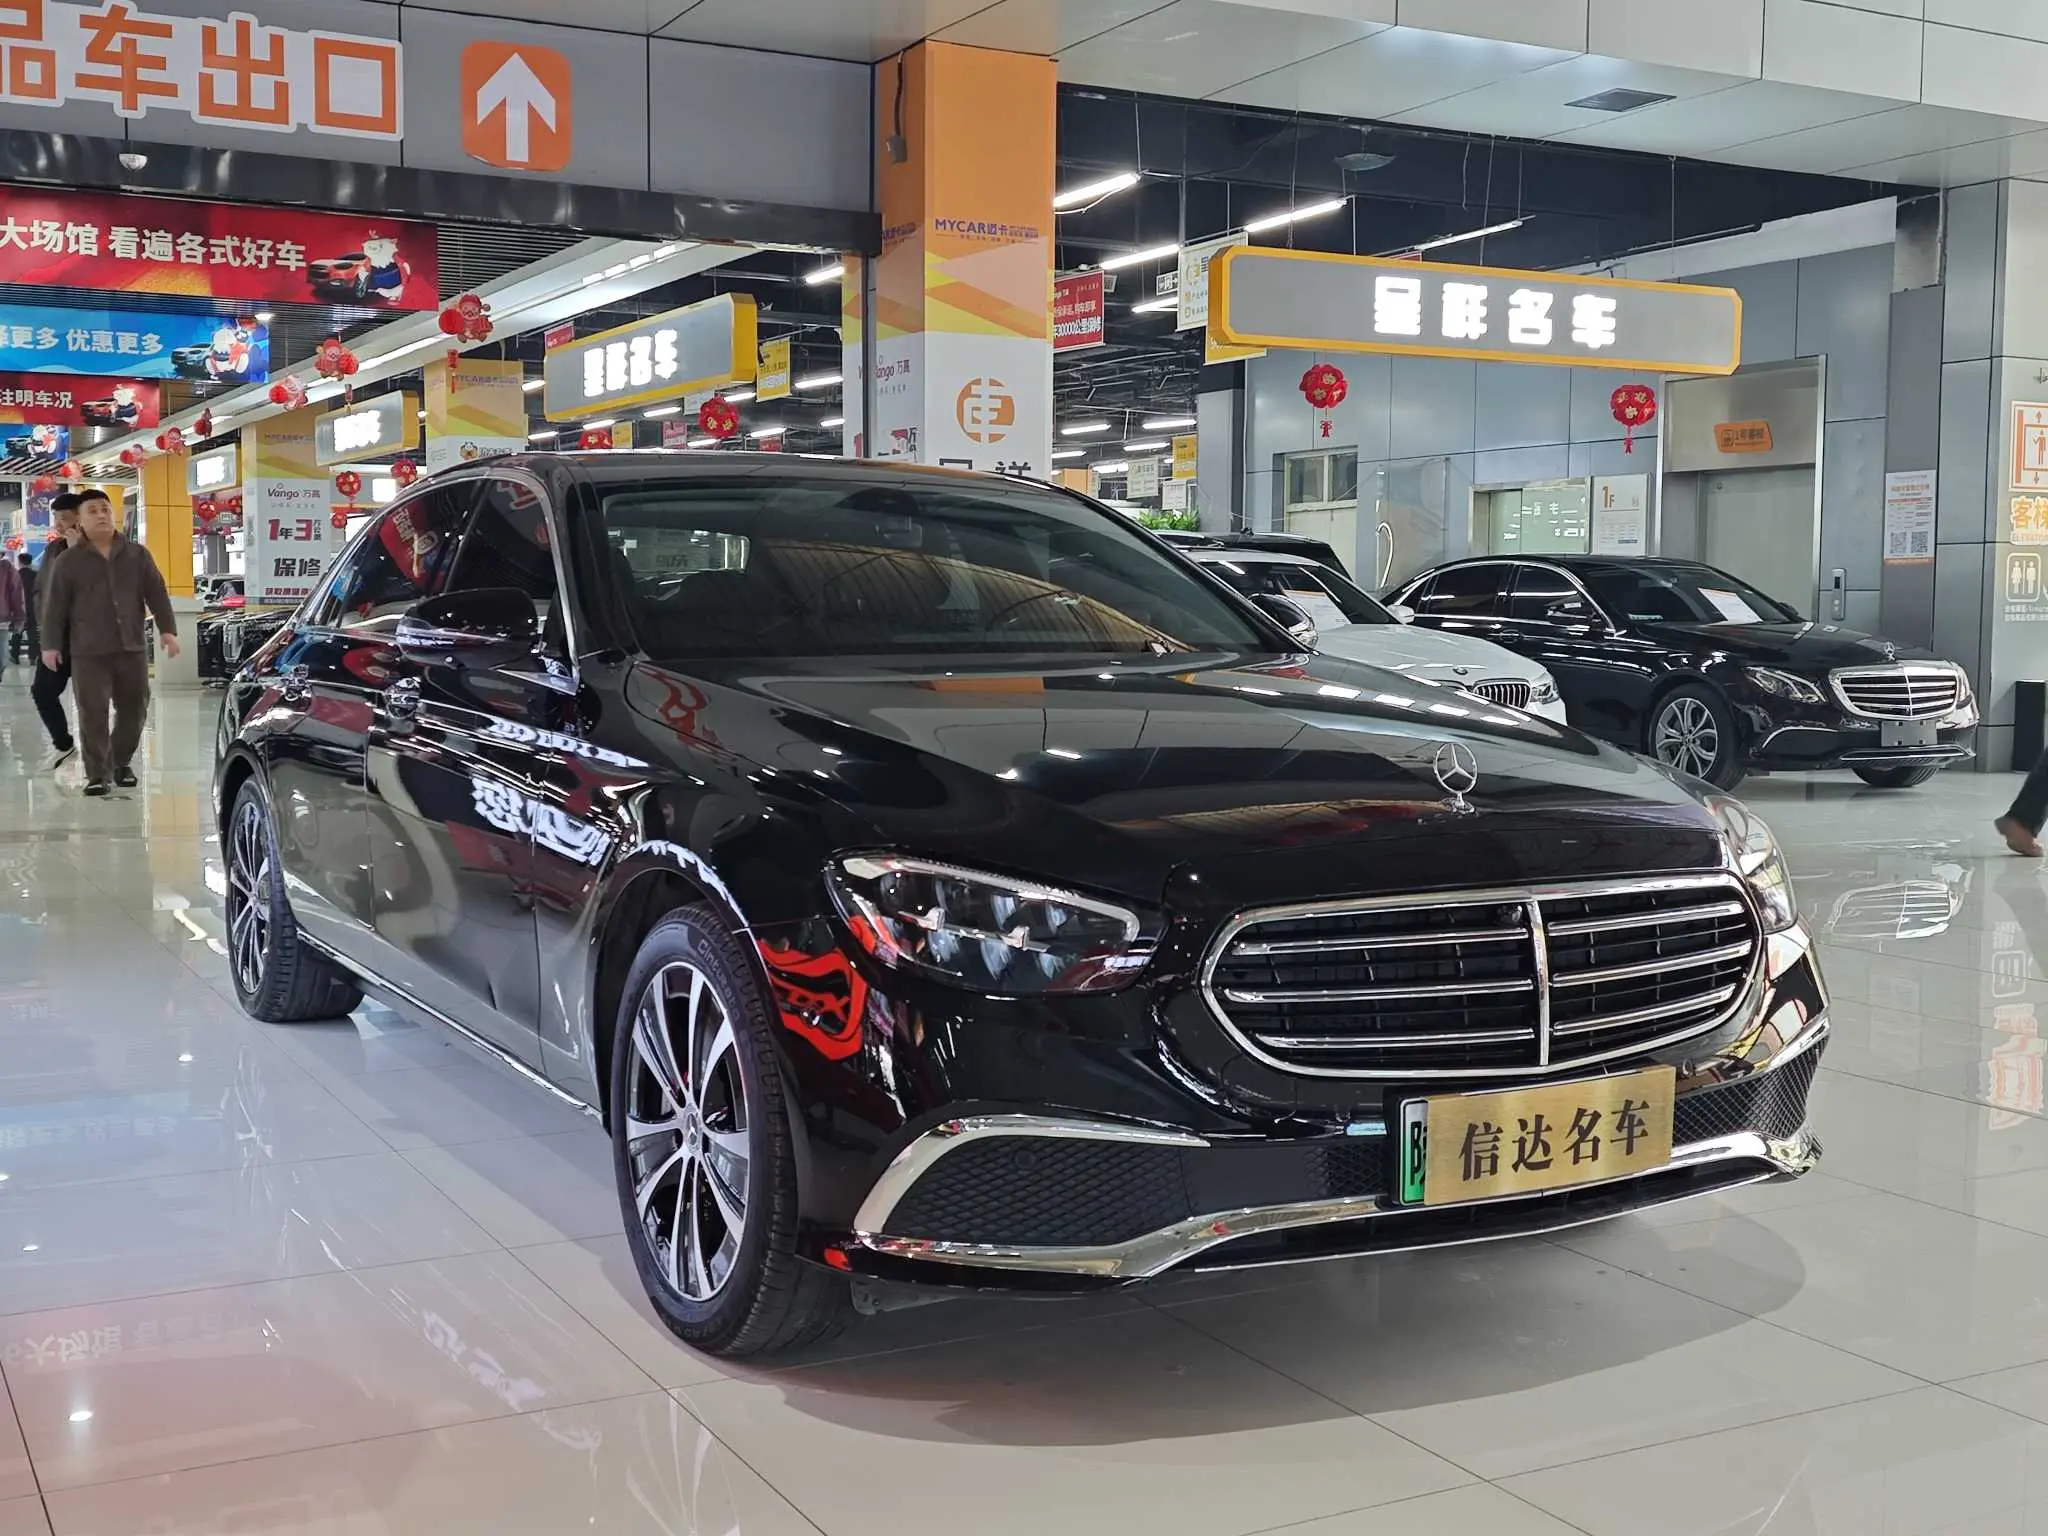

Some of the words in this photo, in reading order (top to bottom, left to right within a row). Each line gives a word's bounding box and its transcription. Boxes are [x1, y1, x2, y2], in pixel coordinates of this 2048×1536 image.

[108, 226, 307, 272] 看遍各式好车
[66, 328, 164, 355] 优惠更多
[267, 489, 299, 500] Vango
[273, 558, 321, 577] 保修
[1458, 1099, 1650, 1182] 信达名车
